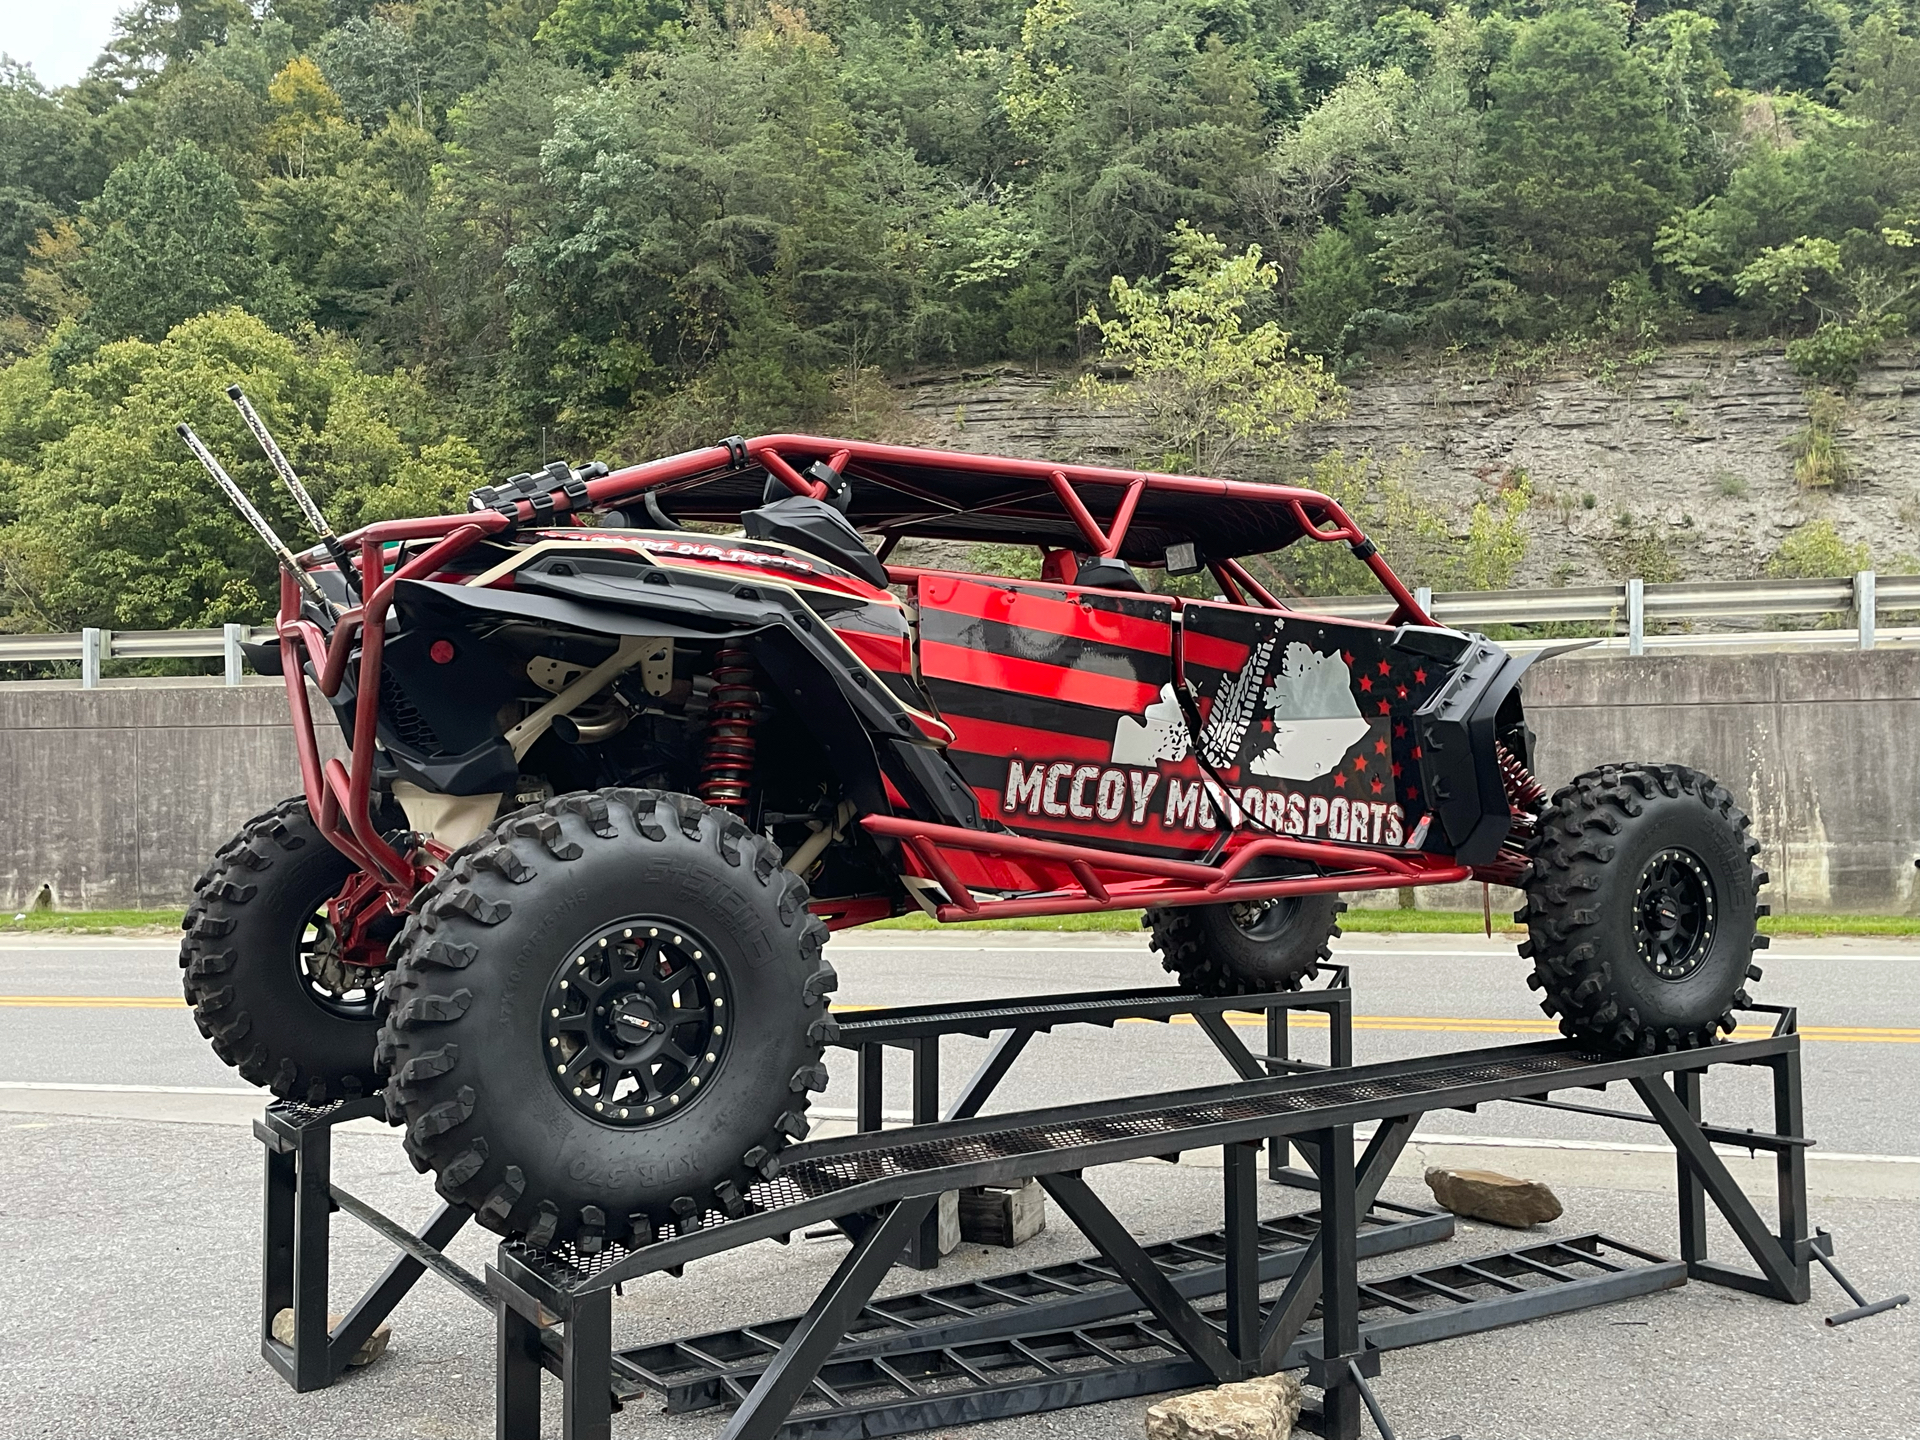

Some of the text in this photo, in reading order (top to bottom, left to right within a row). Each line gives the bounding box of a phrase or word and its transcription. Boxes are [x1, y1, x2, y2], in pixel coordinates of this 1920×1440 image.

[1003, 760, 1404, 846] MCCOY MOTORSPORTS
[642, 856, 765, 933] SYSTEM
